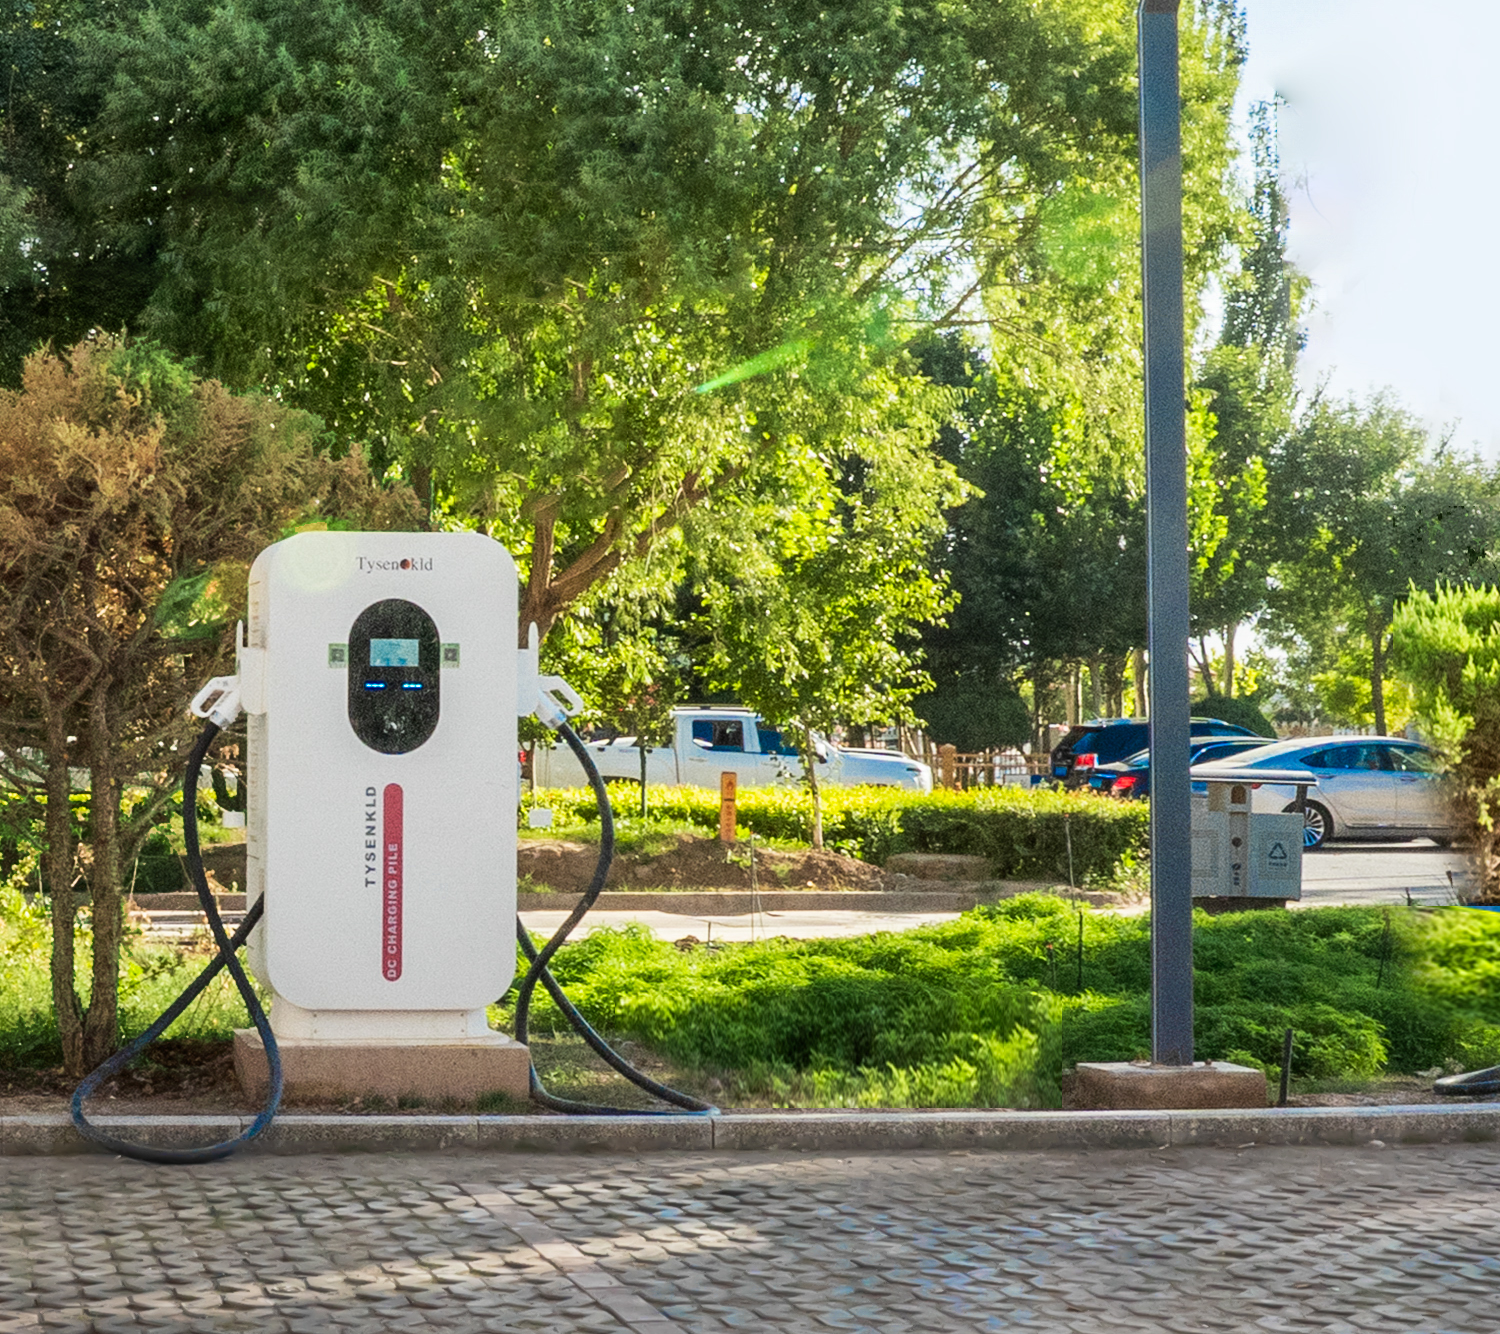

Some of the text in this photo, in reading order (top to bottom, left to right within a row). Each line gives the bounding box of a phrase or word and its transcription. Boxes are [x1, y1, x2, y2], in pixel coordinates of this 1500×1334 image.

[364, 786, 377, 888] TYSENKLD
[387, 843, 398, 978] DC CHARGING PILE
